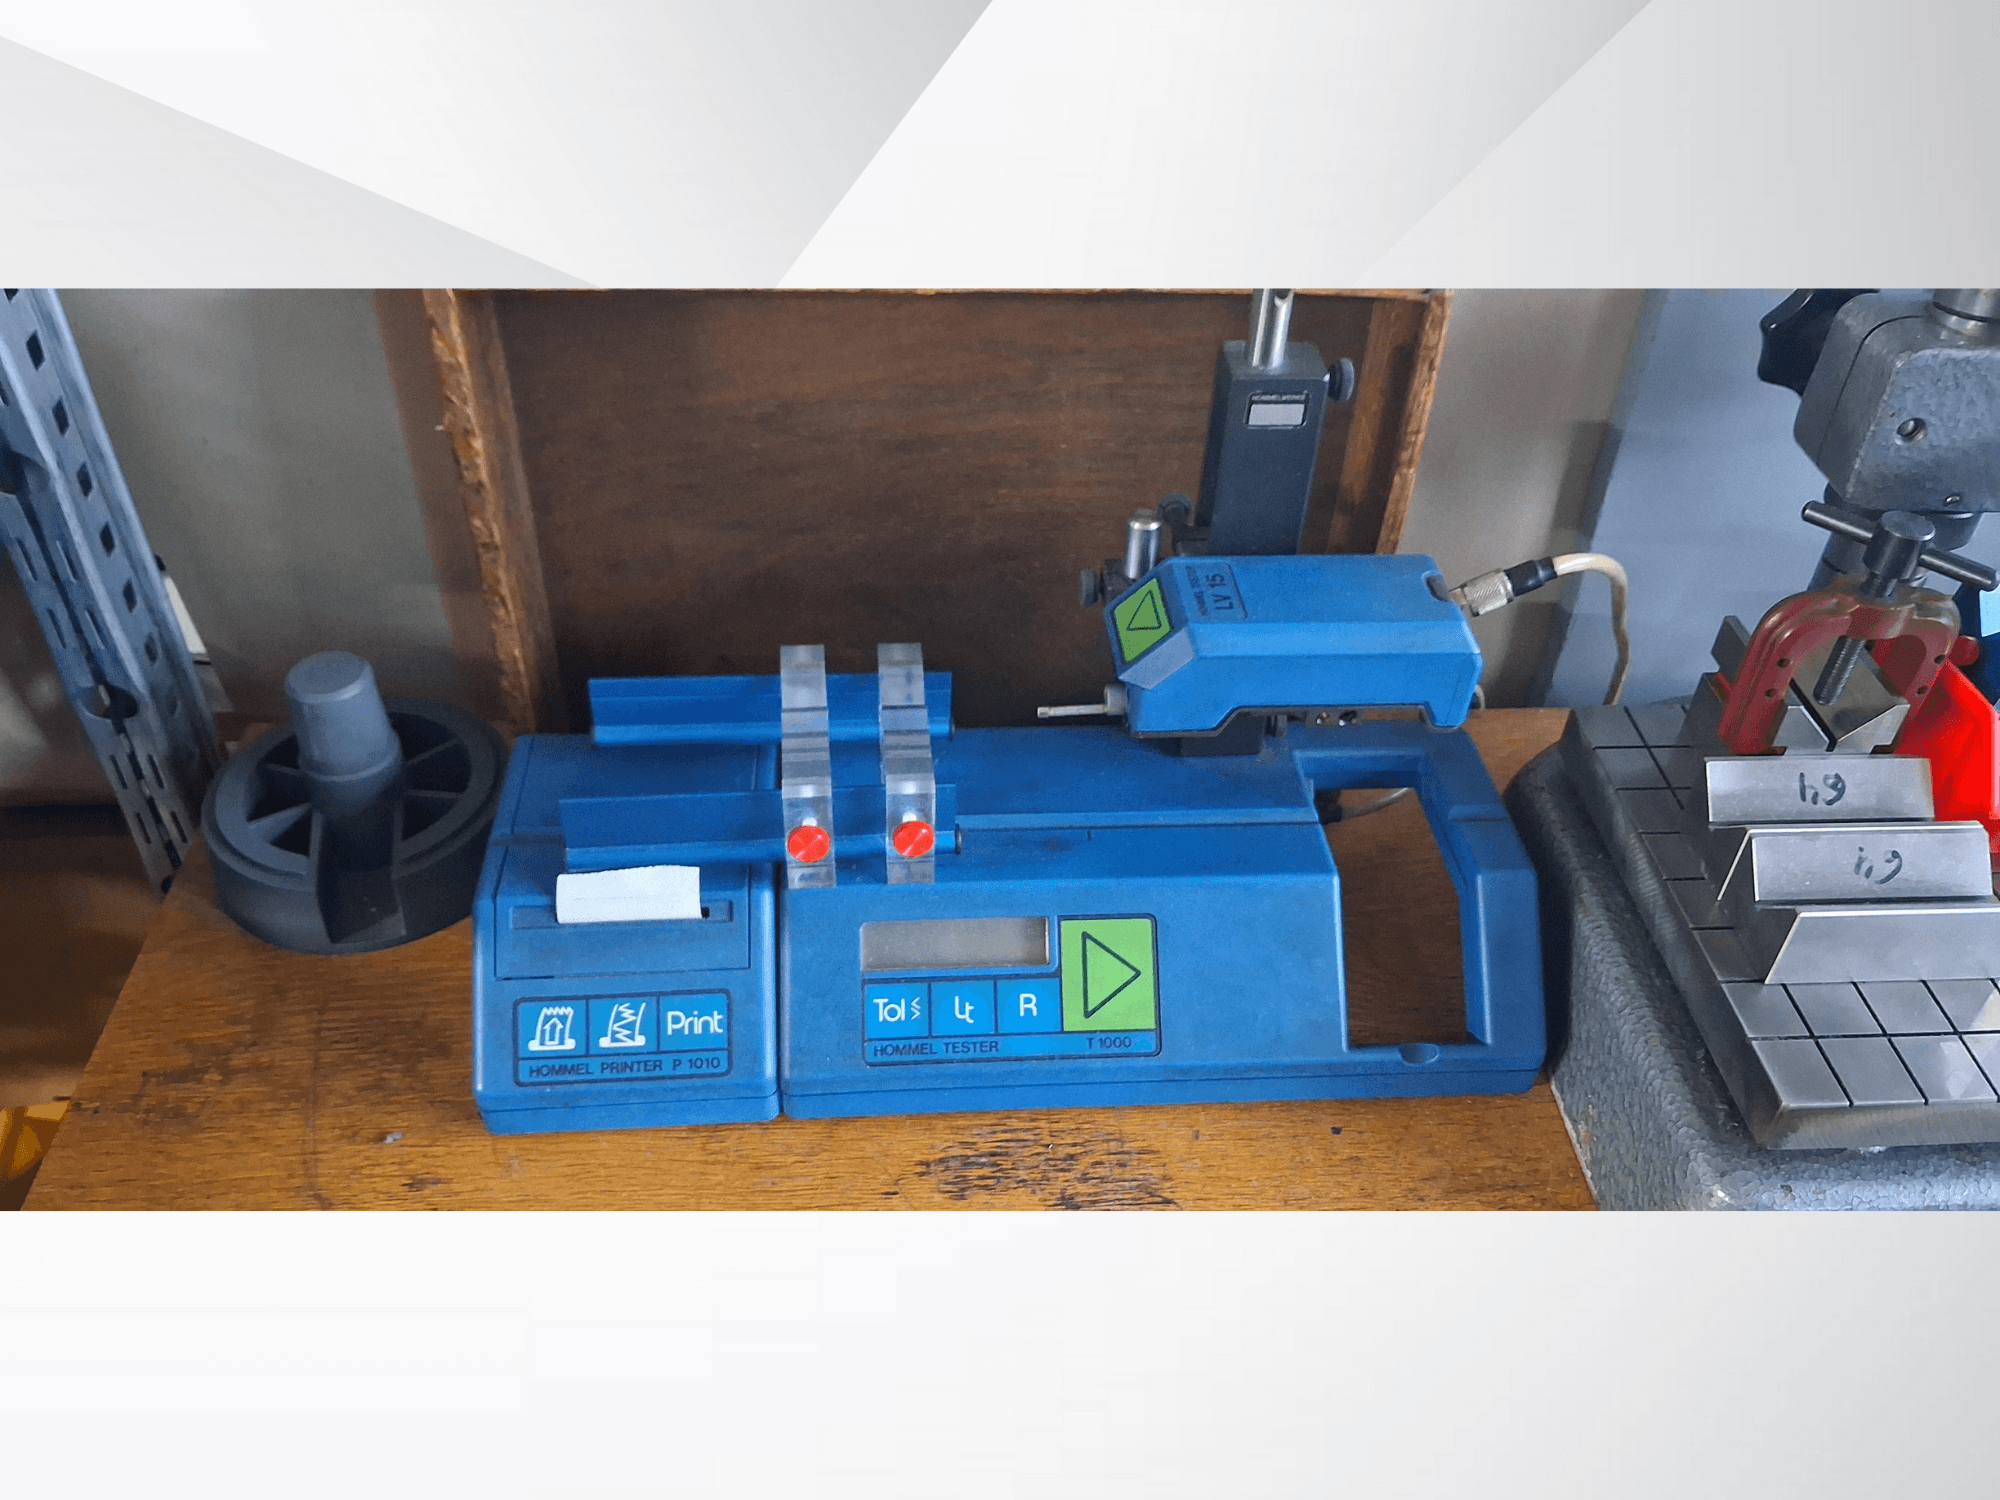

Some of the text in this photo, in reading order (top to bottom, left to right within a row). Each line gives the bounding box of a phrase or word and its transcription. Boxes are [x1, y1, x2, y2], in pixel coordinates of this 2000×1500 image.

[1205, 573, 1234, 611] LV 15
[1019, 993, 1038, 1017] R
[667, 1010, 724, 1035] Print
[873, 1040, 1000, 1057] HOMMEL TESTER
[1086, 1036, 1132, 1049] T 1000
[529, 1056, 721, 1077] HOMMEL PRINTER P 1010
